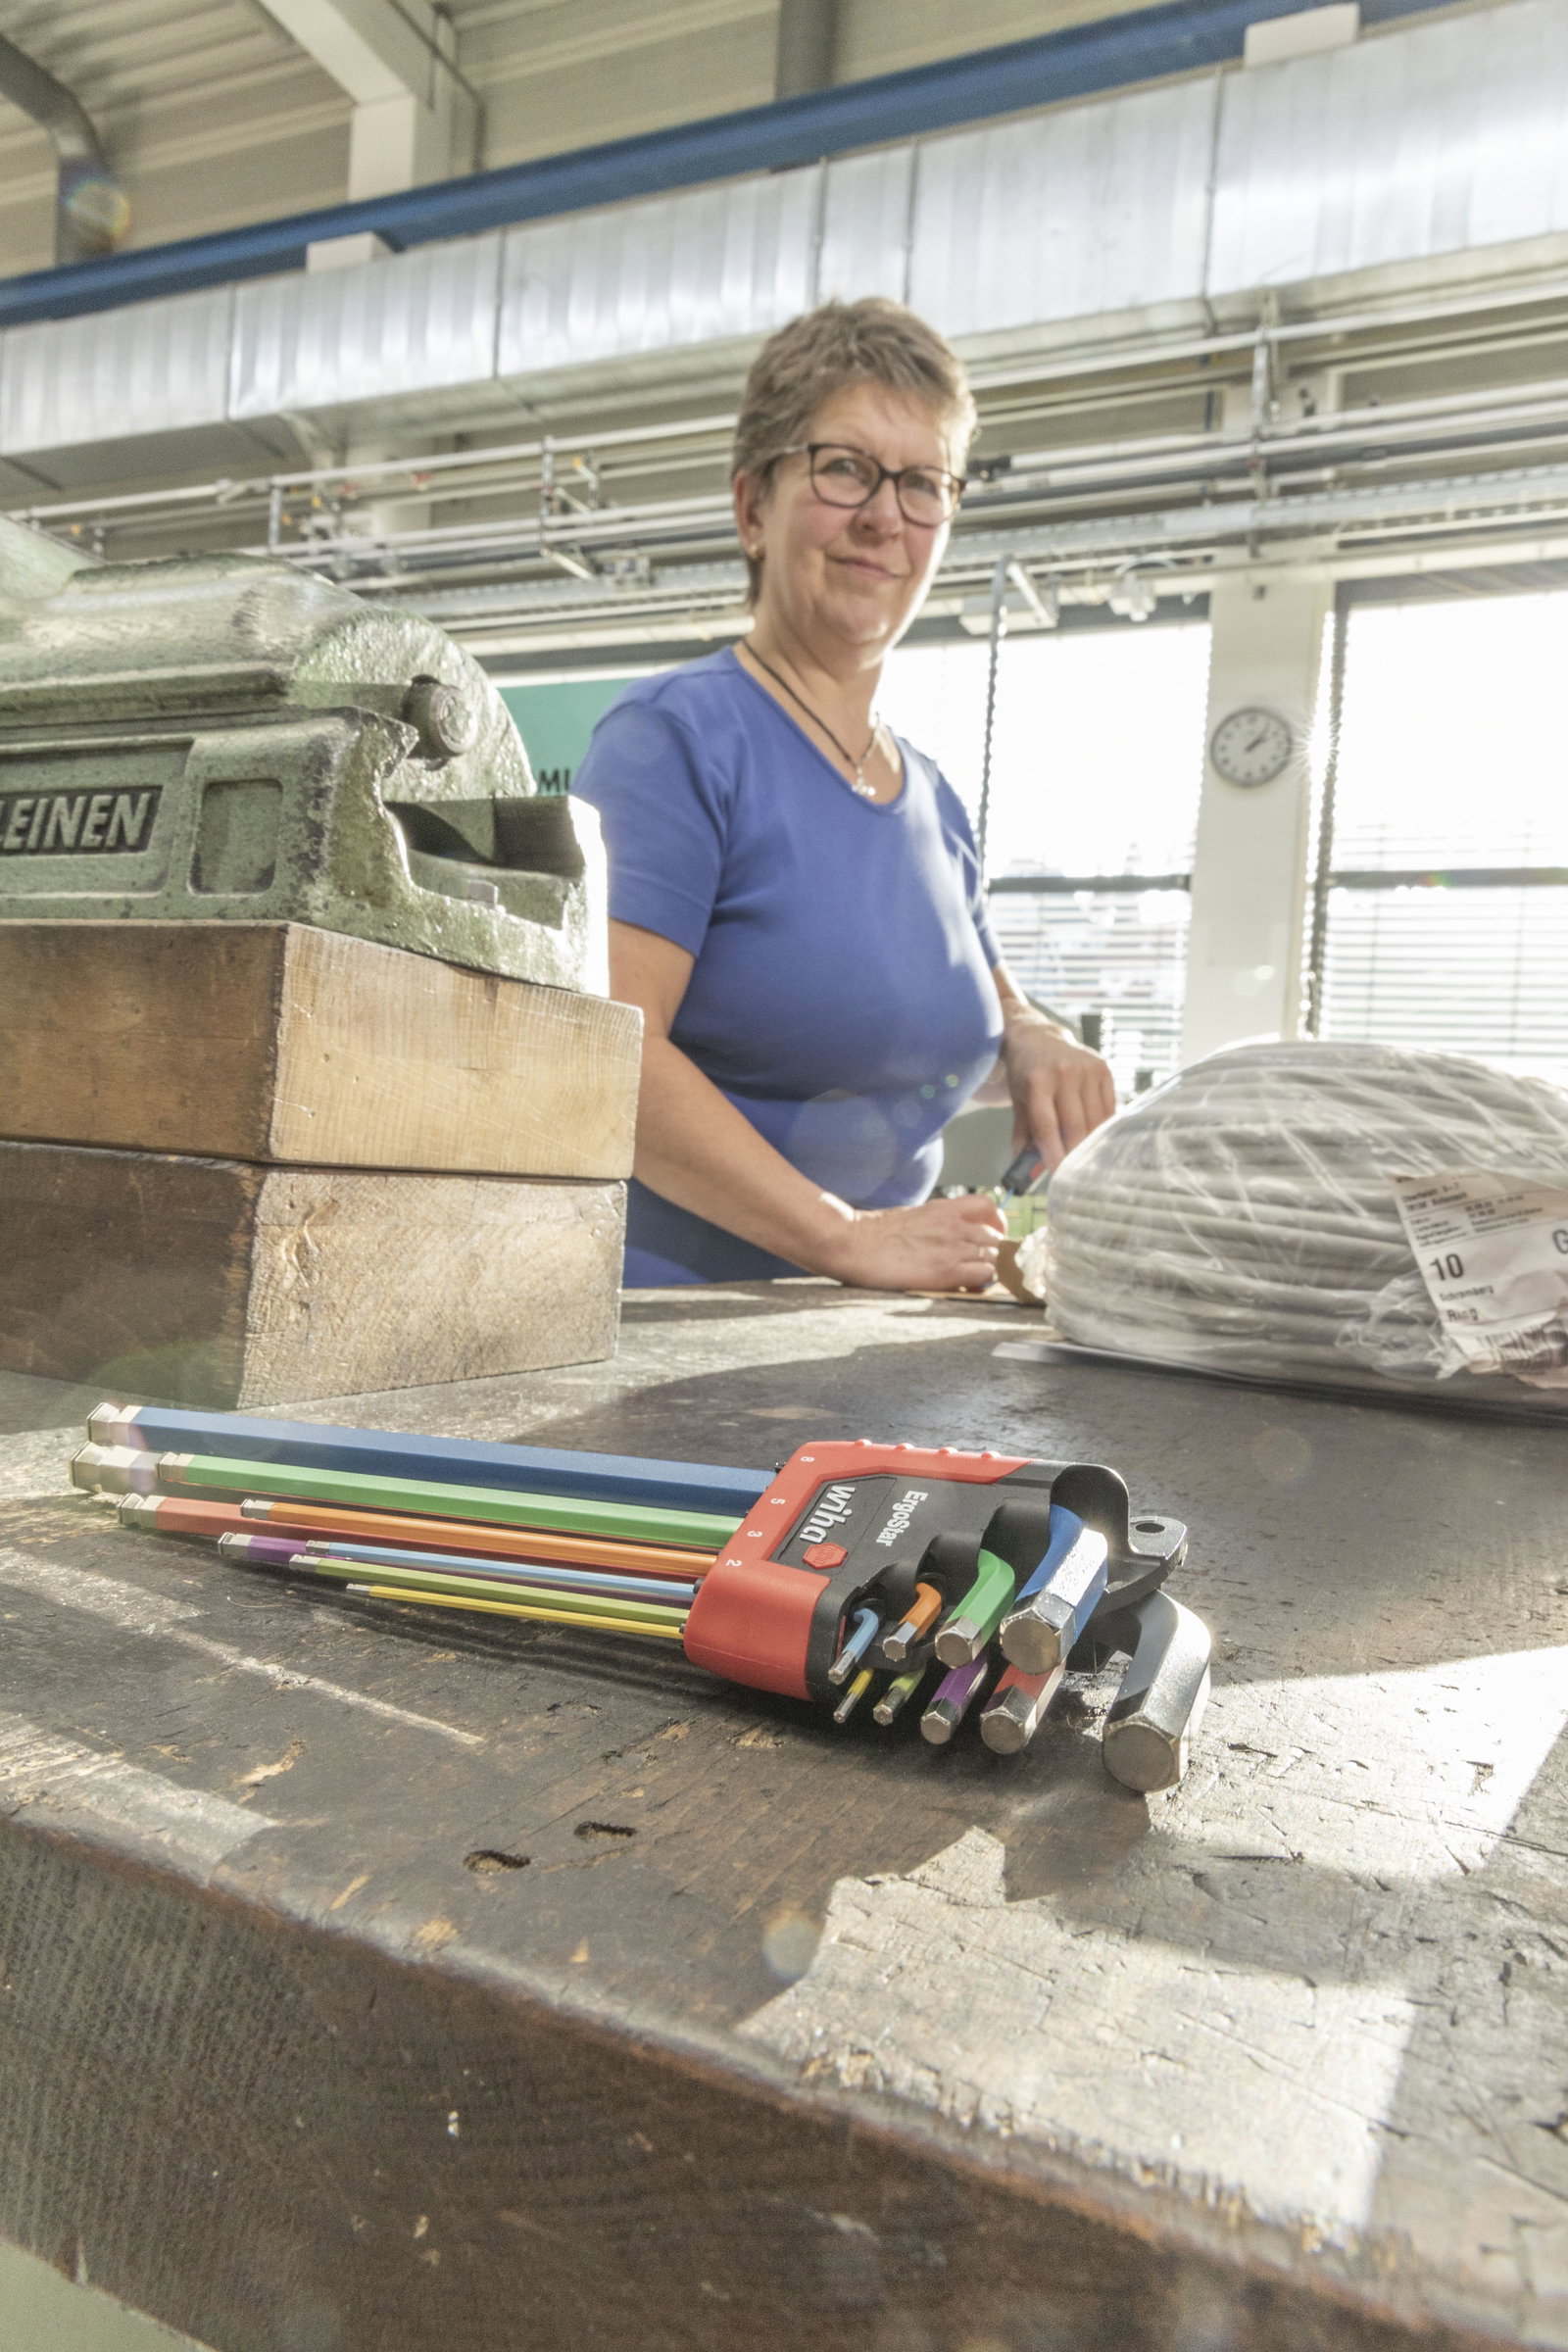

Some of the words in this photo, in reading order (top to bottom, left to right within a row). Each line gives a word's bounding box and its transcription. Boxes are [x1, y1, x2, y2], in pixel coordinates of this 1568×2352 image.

[0, 793, 151, 849] EINEN
[1430, 1253, 1464, 1281] 10
[875, 1490, 929, 1547] ErgoStar
[725, 1558, 743, 1567] 2
